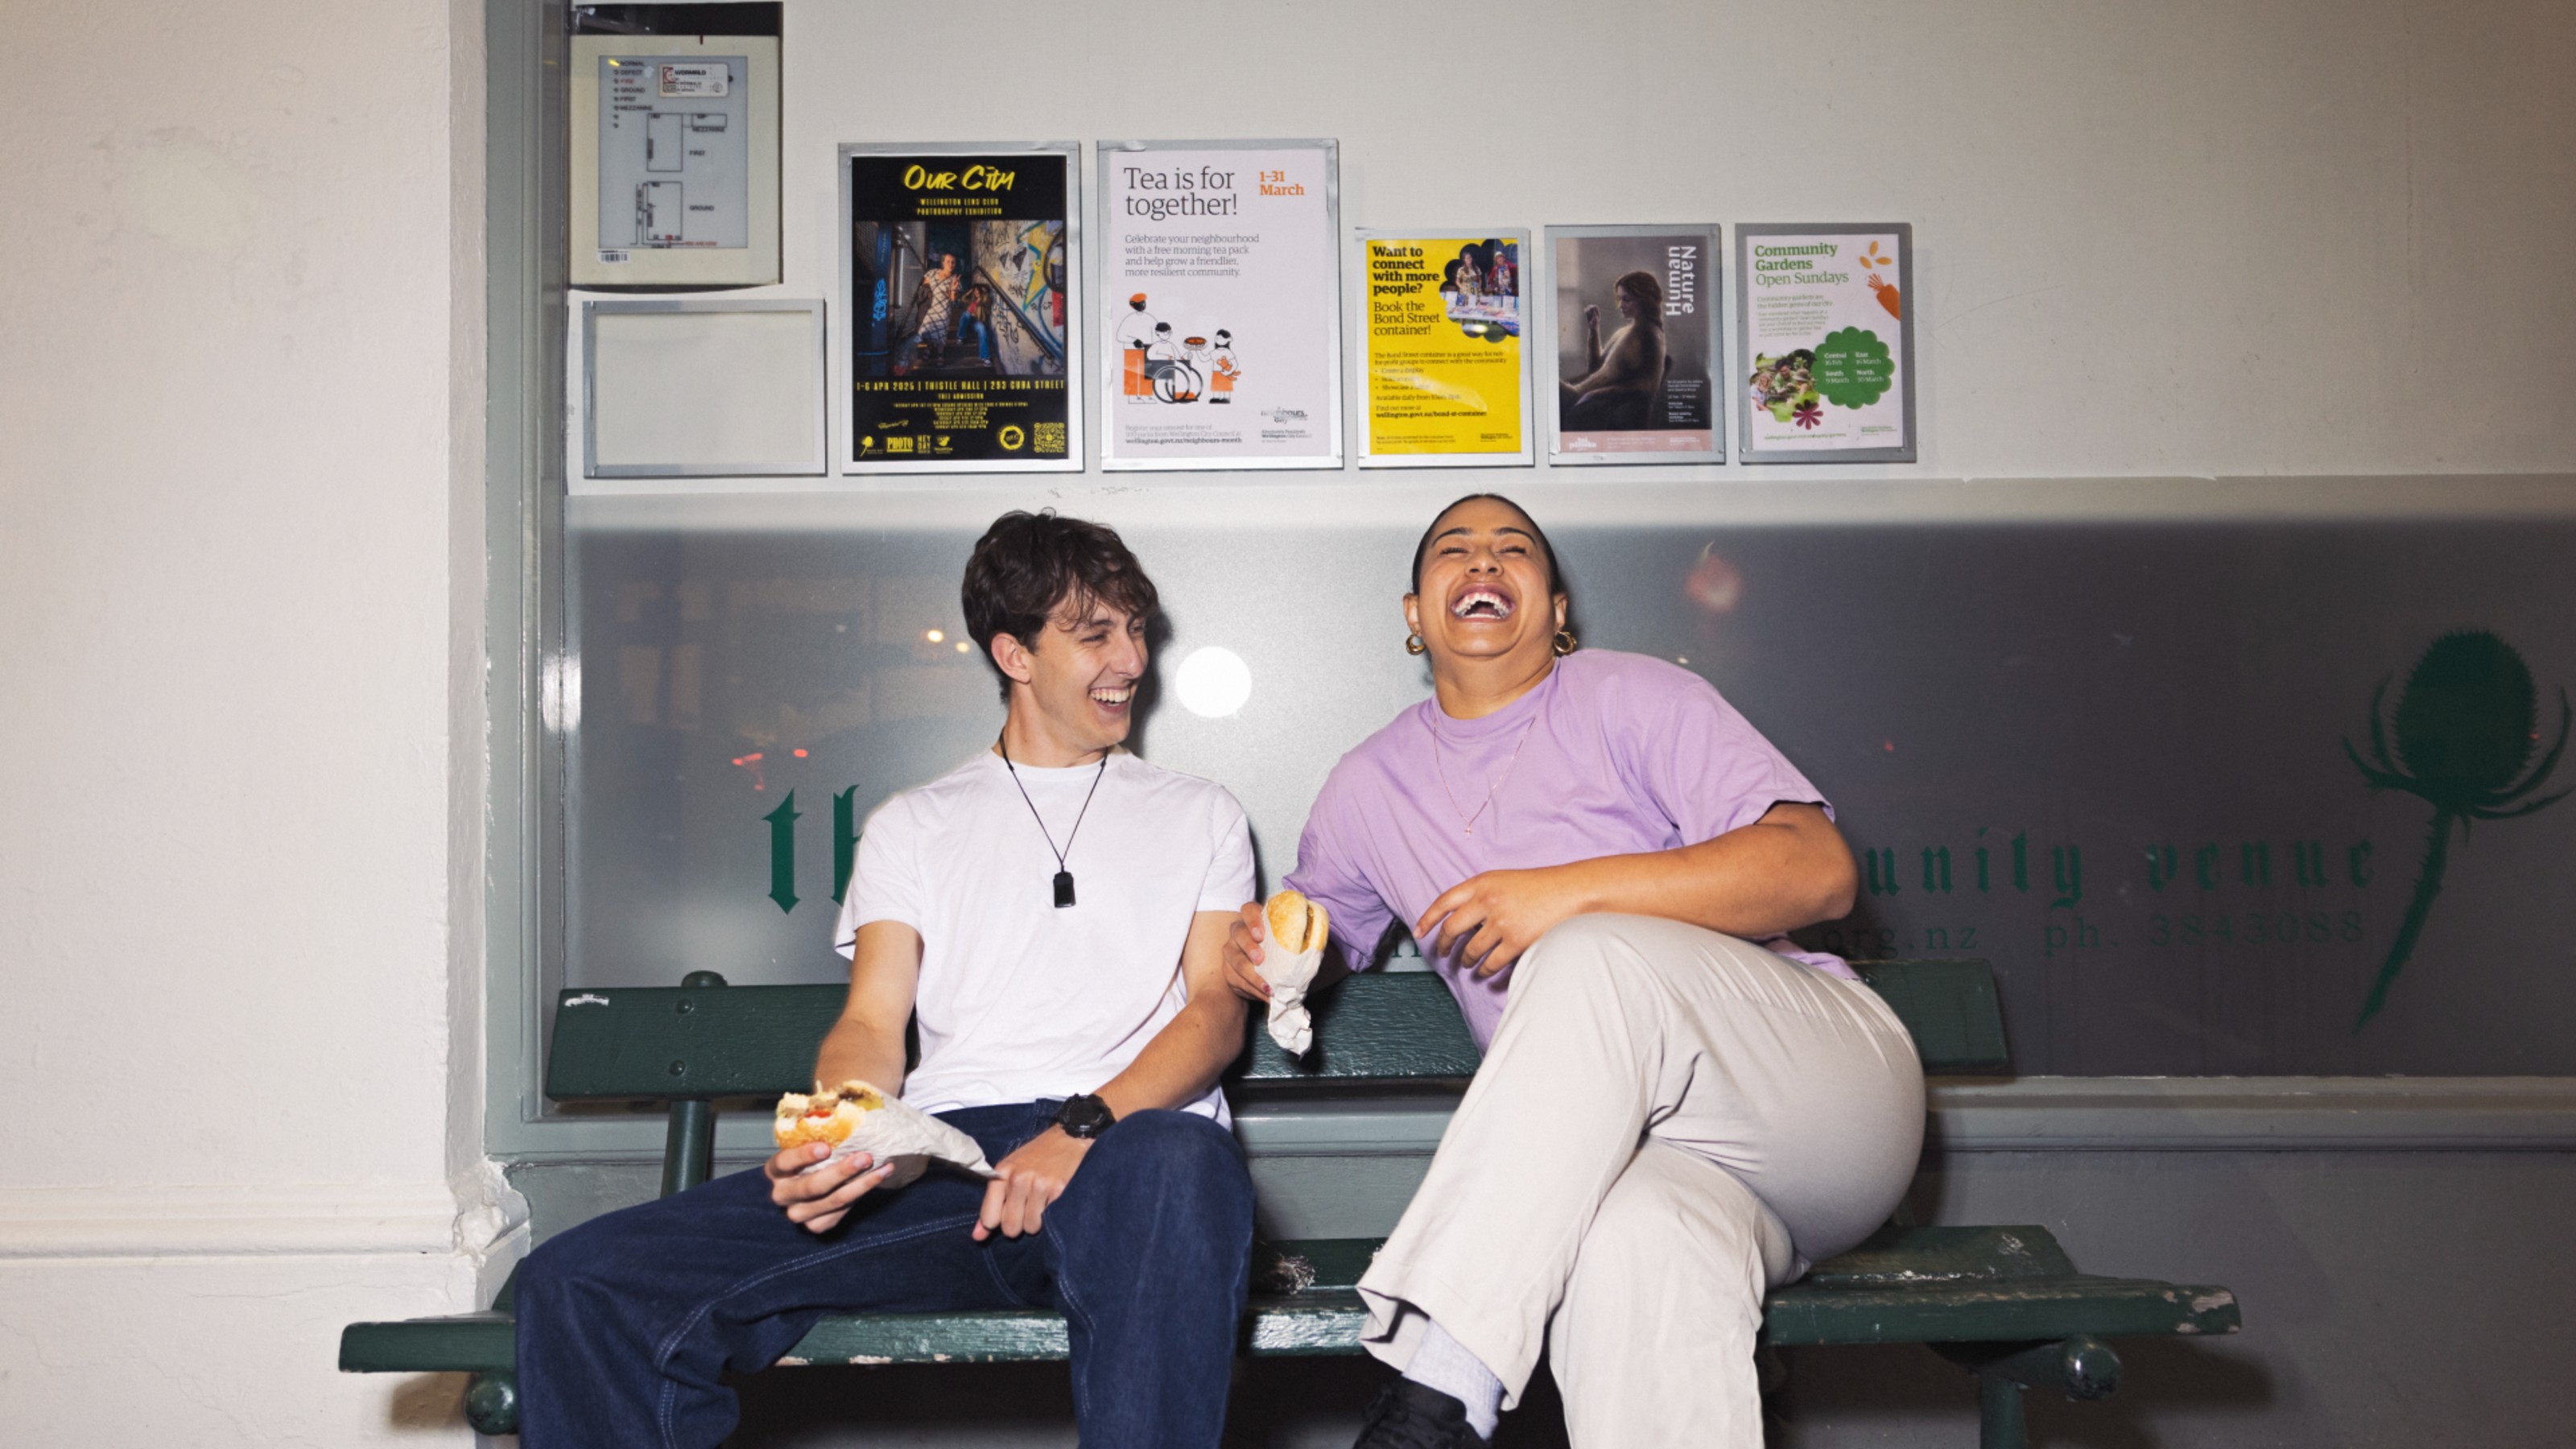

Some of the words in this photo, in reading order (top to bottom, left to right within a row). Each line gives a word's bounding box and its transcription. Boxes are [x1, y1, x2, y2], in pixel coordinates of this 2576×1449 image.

[1124, 167, 1167, 190] Tea
[1174, 167, 1195, 190] is
[1200, 166, 1235, 190] for
[1259, 184, 1305, 196] March
[1125, 192, 1237, 221] together!
[1125, 234, 1167, 244] Celebrate
[1168, 236, 1188, 245] your
[1191, 233, 1260, 245] neighbourhood
[1125, 245, 1146, 254] with
[1154, 245, 1172, 254] free
[1173, 246, 1212, 255] morning
[1213, 246, 1227, 254] tea
[1228, 246, 1249, 255] pack
[1373, 246, 1407, 257] Want
[1410, 246, 1423, 257] to
[1755, 243, 1838, 257] Community
[1125, 256, 1142, 266] and
[1144, 256, 1164, 267] help
[1166, 258, 1187, 267] grow
[1373, 259, 1425, 270] connect
[1755, 259, 1813, 271] Gardens
[1125, 269, 1149, 277] more
[1150, 267, 1186, 277] resilient
[1373, 271, 1403, 282] with
[1406, 272, 1440, 282] more
[1666, 246, 1682, 316] Human
[1681, 246, 1697, 315] Nature
[1756, 274, 1791, 288] Open
[1794, 271, 1849, 285] Sundays
[1373, 283, 1423, 296] people?
[1373, 302, 1403, 312] Book
[1406, 301, 1425, 312] the
[1374, 313, 1404, 324] Bond
[1406, 312, 1440, 324] Street
[1374, 324, 1431, 336] container!
[873, 382, 890, 391] APR
[893, 382, 914, 391] 2025
[925, 381, 958, 390] THISTLE
[961, 381, 980, 390] HALL
[1009, 381, 1031, 390] CUBA
[1034, 380, 1063, 390] STREET
[2147, 836, 2375, 892] venue
[2044, 916, 2120, 959] ph.
[2149, 910, 2364, 947] 3843088
